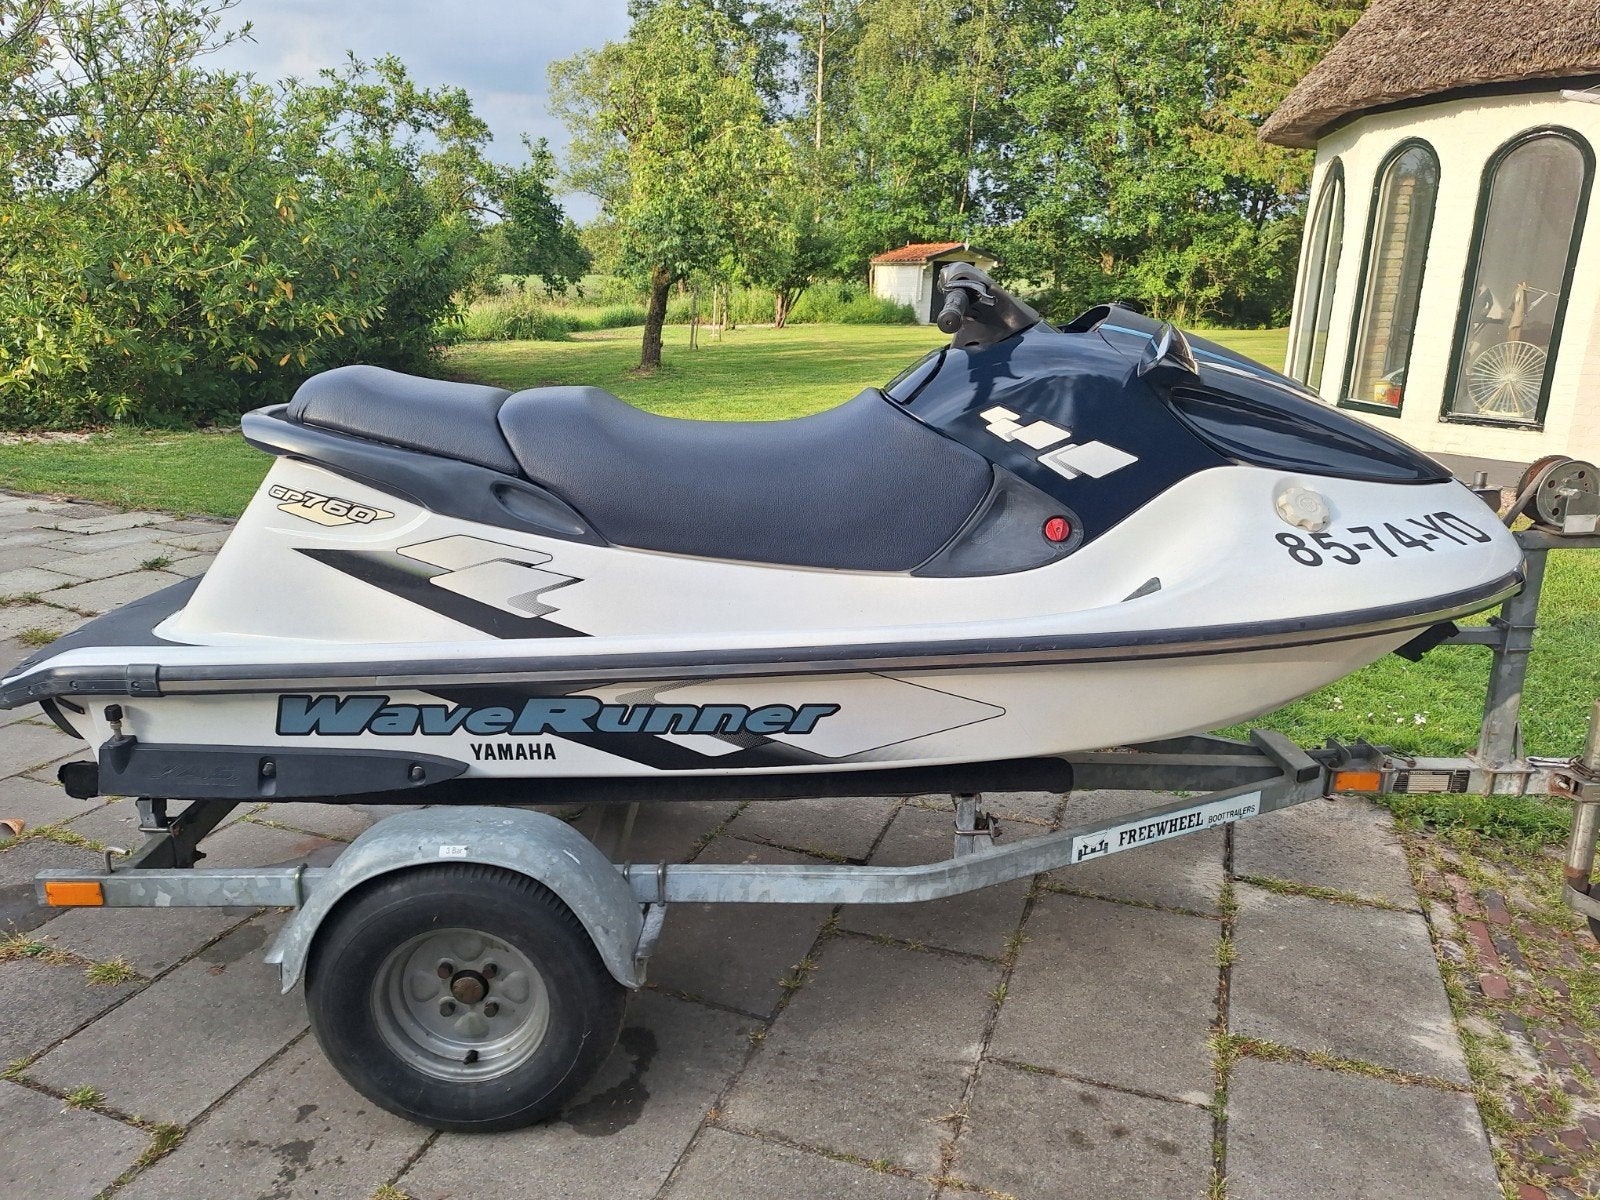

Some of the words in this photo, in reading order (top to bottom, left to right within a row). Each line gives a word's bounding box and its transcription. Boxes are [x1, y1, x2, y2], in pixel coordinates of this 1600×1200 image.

[1275, 511, 1492, 567] 85-74-YD
[276, 694, 841, 736] WaveRunner
[470, 743, 556, 760] YAMAHA
[1119, 812, 1203, 846] FREEWHEEL
